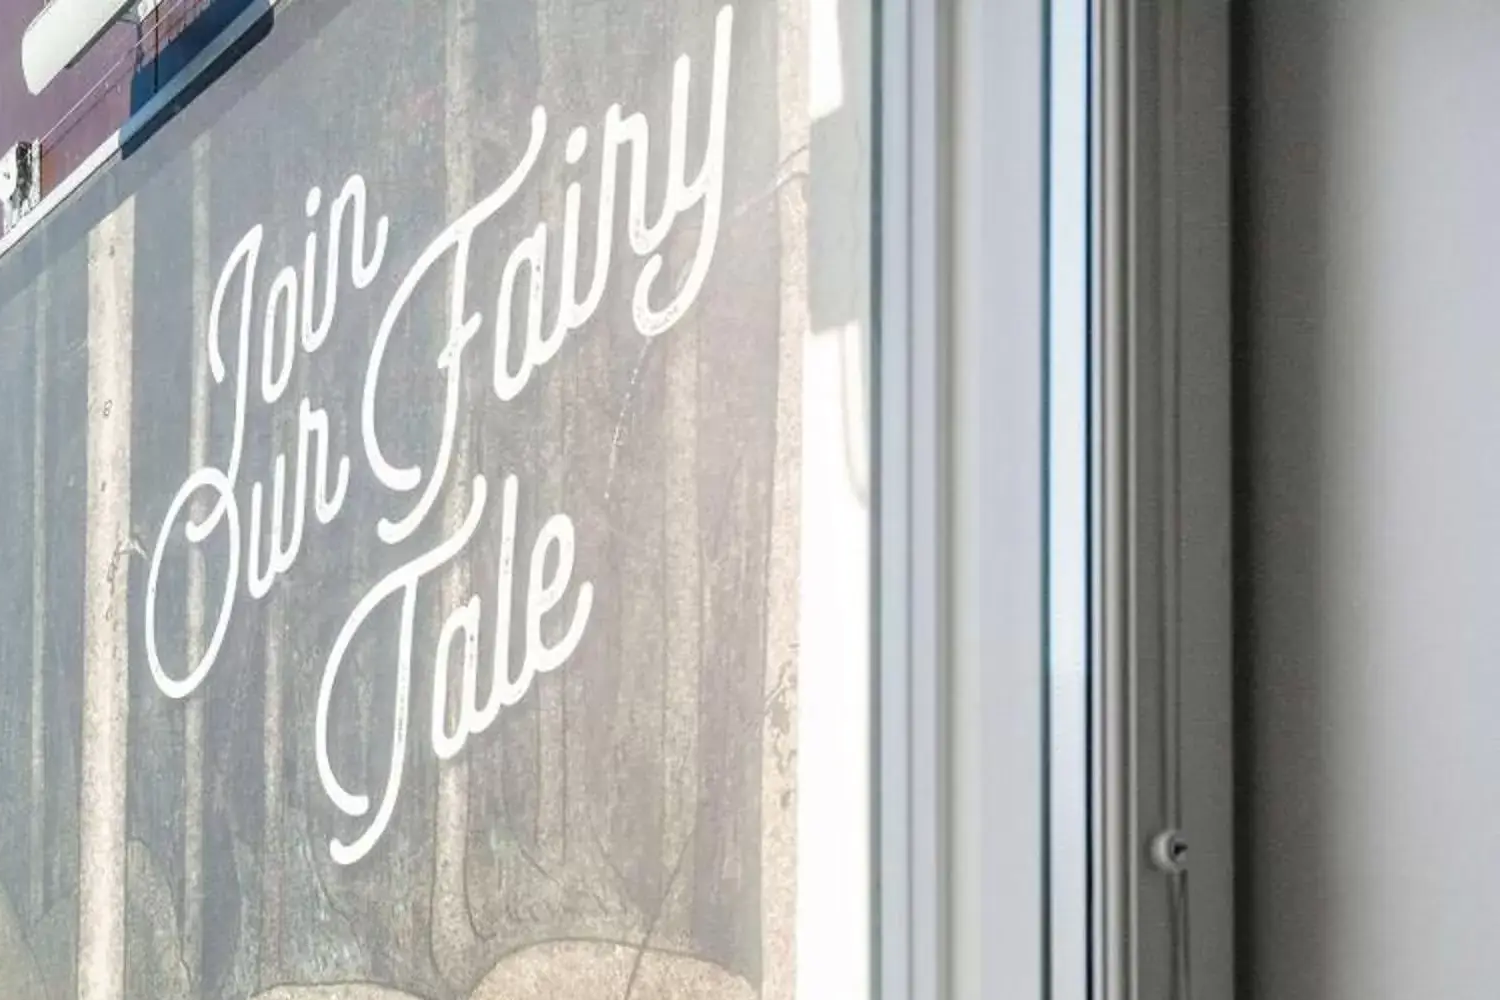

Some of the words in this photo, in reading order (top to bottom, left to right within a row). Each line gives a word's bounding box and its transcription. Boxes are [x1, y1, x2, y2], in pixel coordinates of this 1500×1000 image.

[145, 398, 350, 698] Our
[362, 5, 733, 544] Fairy
[208, 174, 389, 543] Join
[315, 474, 594, 865] Tale
